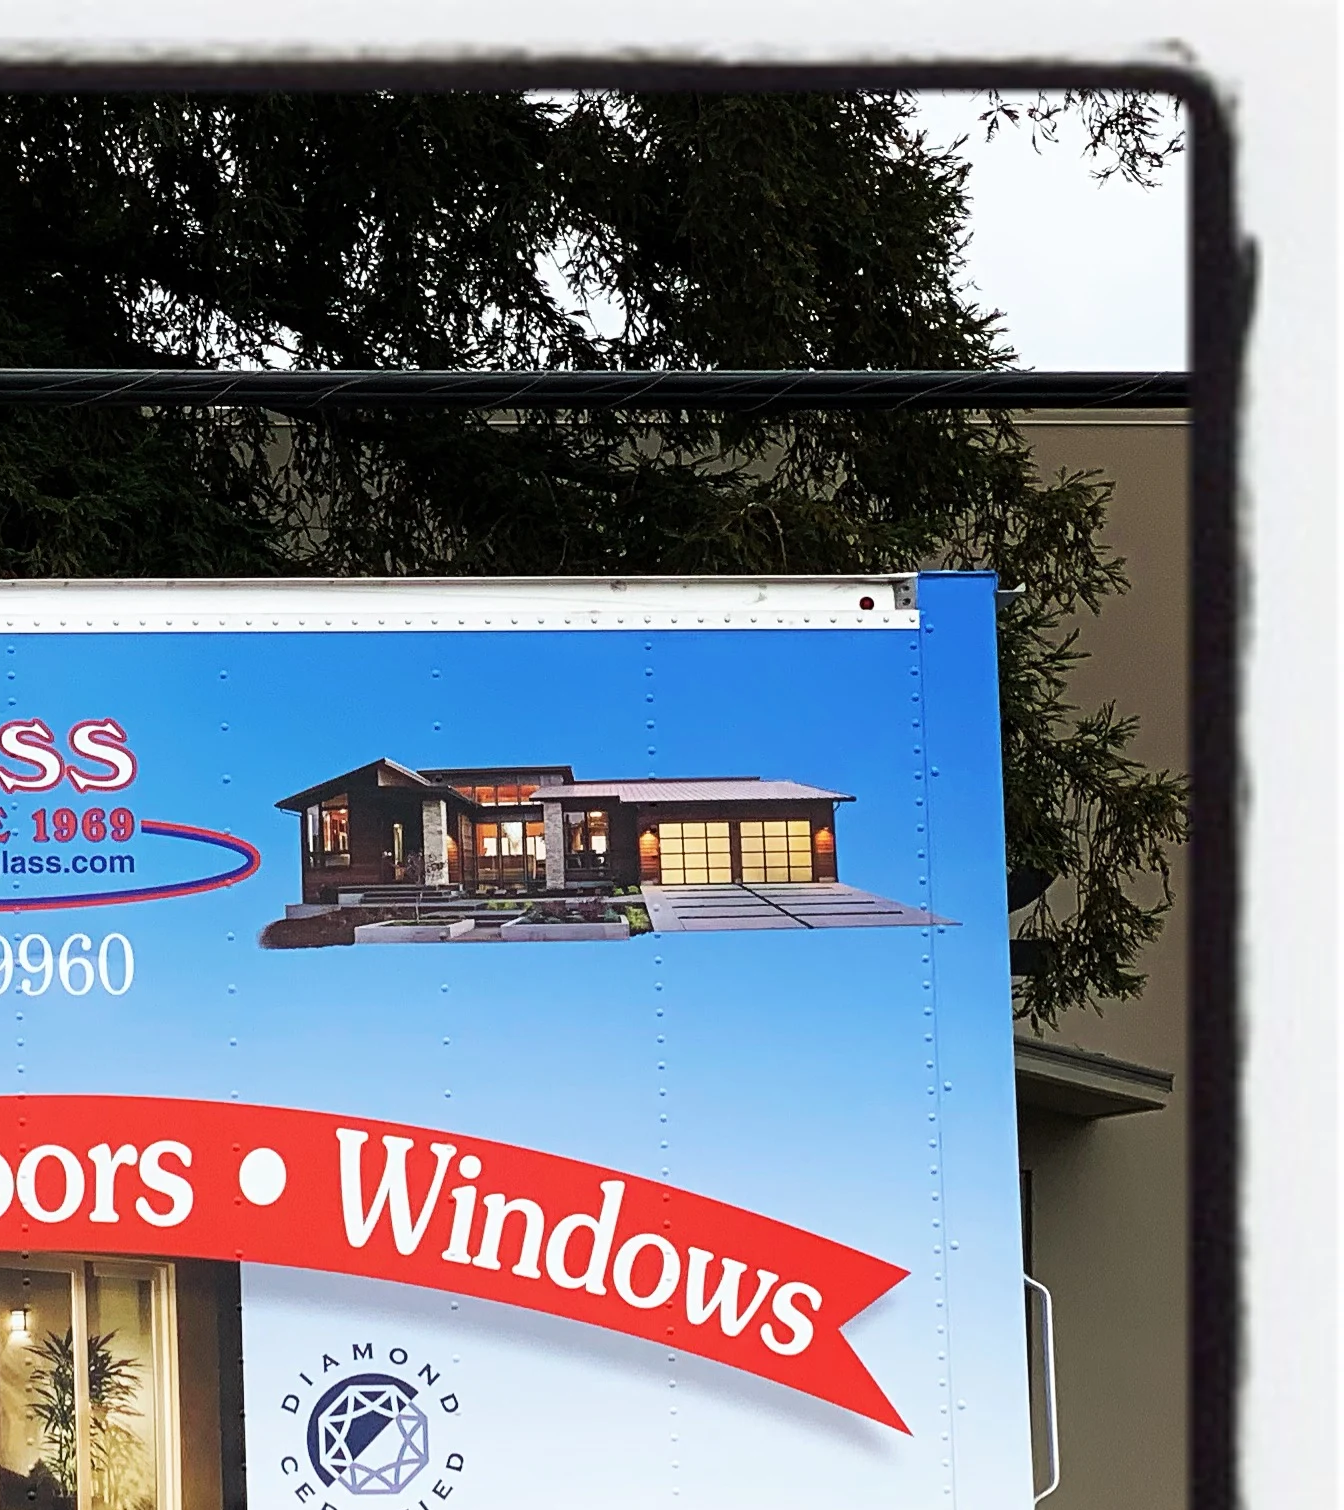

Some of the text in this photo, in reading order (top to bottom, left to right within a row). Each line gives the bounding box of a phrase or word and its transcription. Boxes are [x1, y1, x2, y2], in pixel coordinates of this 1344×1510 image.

[31, 807, 135, 843] 1969
[335, 1127, 823, 1357] Windows
[281, 1343, 460, 1414] DIAMOND
